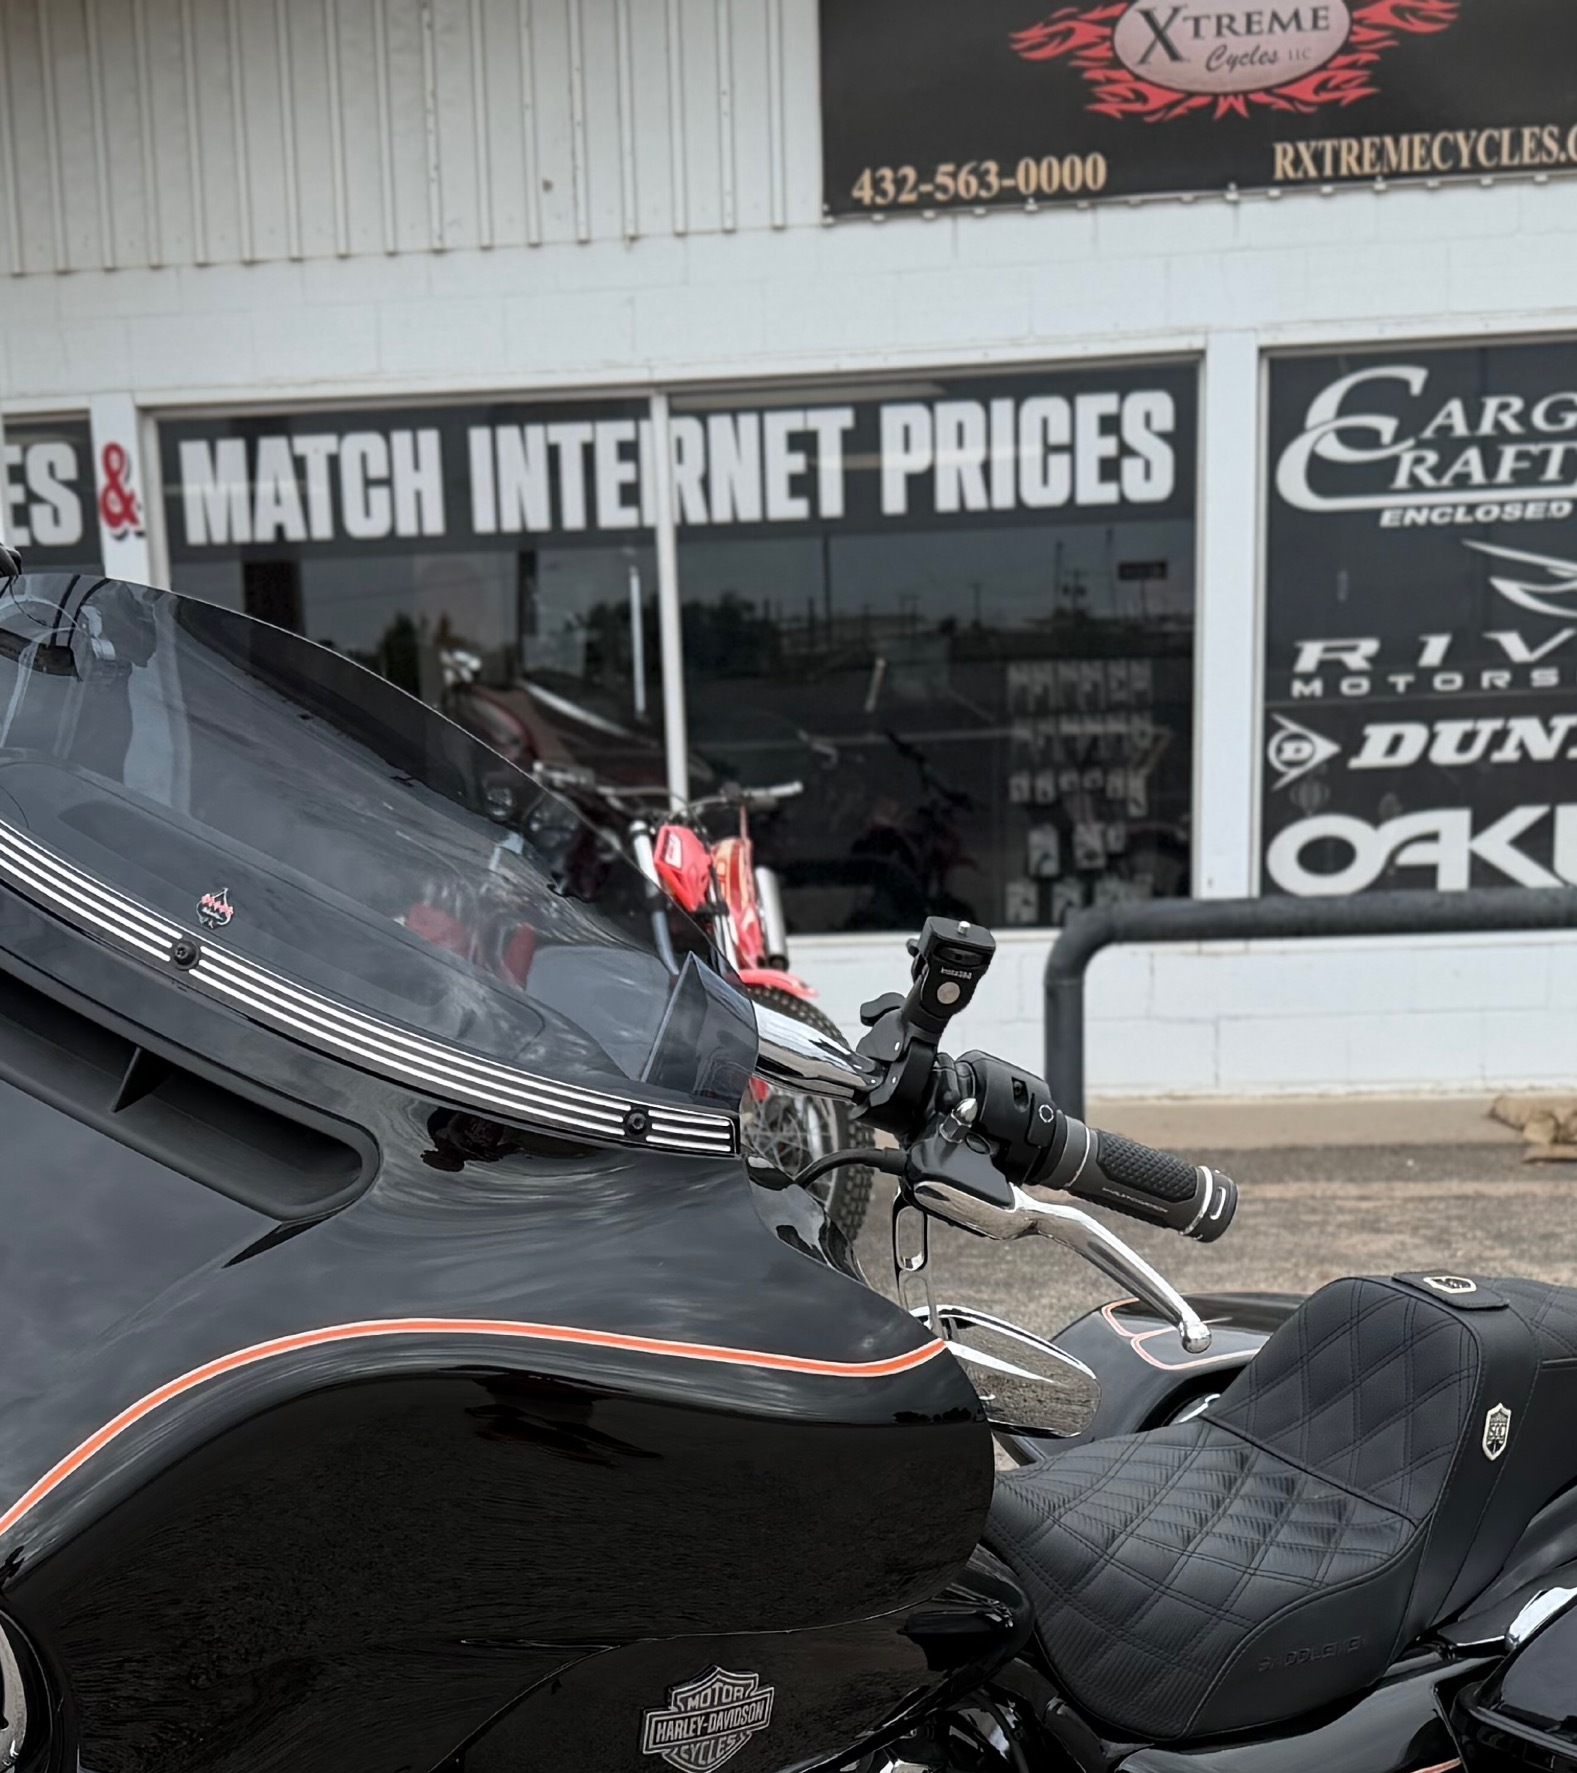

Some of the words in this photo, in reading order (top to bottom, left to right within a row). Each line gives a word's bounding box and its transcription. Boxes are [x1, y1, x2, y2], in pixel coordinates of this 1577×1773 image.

[1134, 4, 1330, 66] XTREME
[1205, 44, 1278, 73] Cycles
[852, 153, 1107, 206] 432-563-0000
[98, 441, 144, 538] &
[178, 428, 446, 546] MATCH
[468, 408, 855, 534] INTERNET
[880, 389, 1176, 516] PRICES
[1380, 501, 1572, 527] ENCLOSED
[687, 1681, 745, 1710] MOTOR
[655, 1699, 766, 1744] HARLEY-DAVIDSON
[681, 1734, 742, 1765] CYCLES
